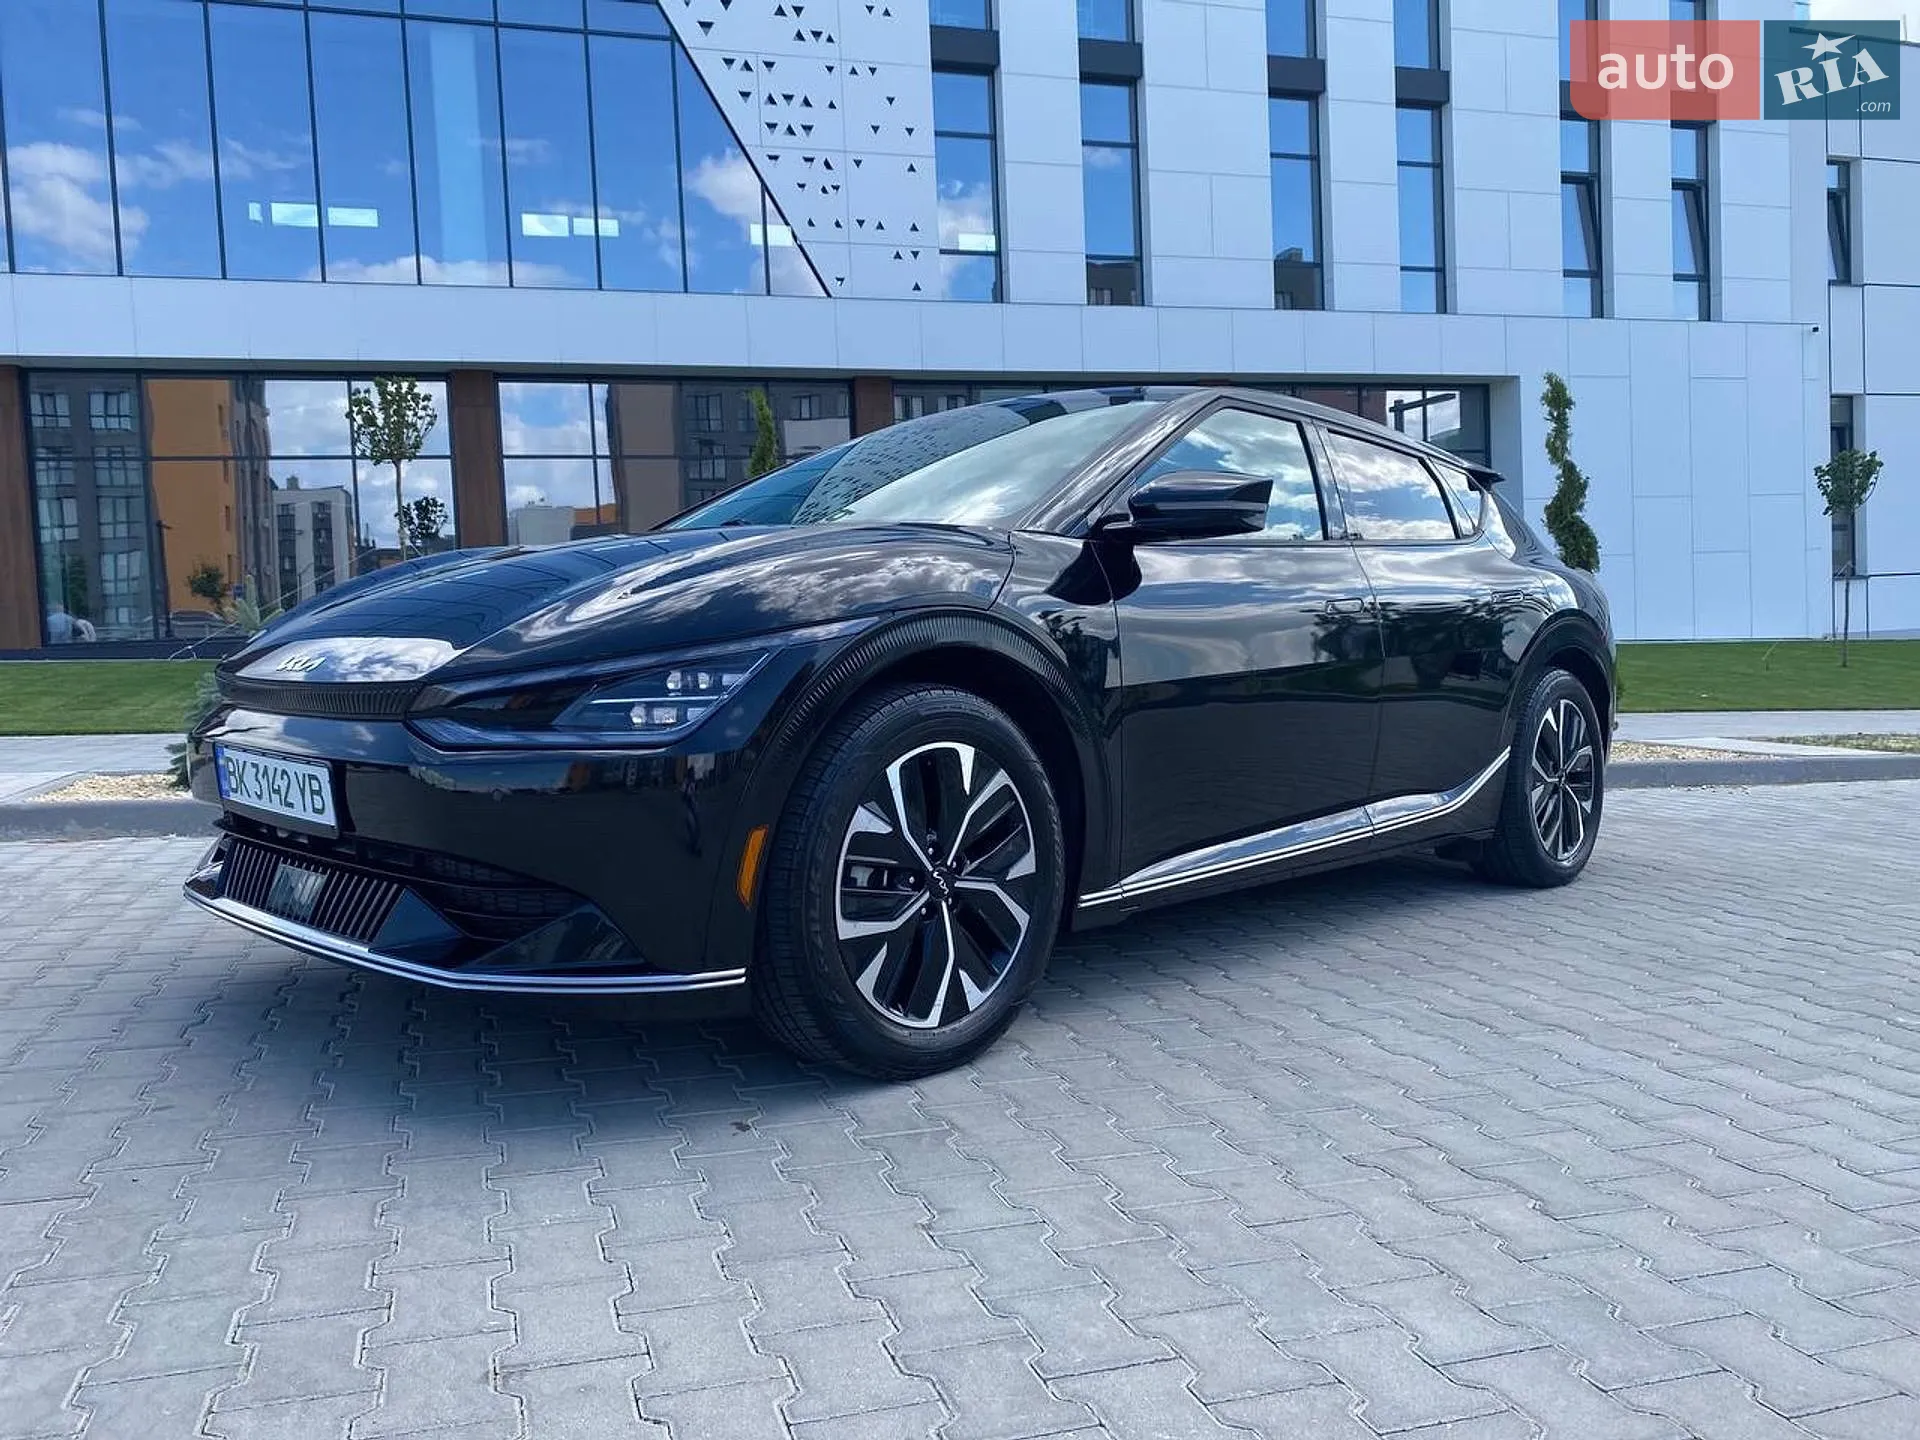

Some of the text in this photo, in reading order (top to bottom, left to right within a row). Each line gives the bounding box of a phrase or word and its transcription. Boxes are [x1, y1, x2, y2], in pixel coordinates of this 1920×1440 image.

[227, 758, 325, 815] BK 3142 YB
